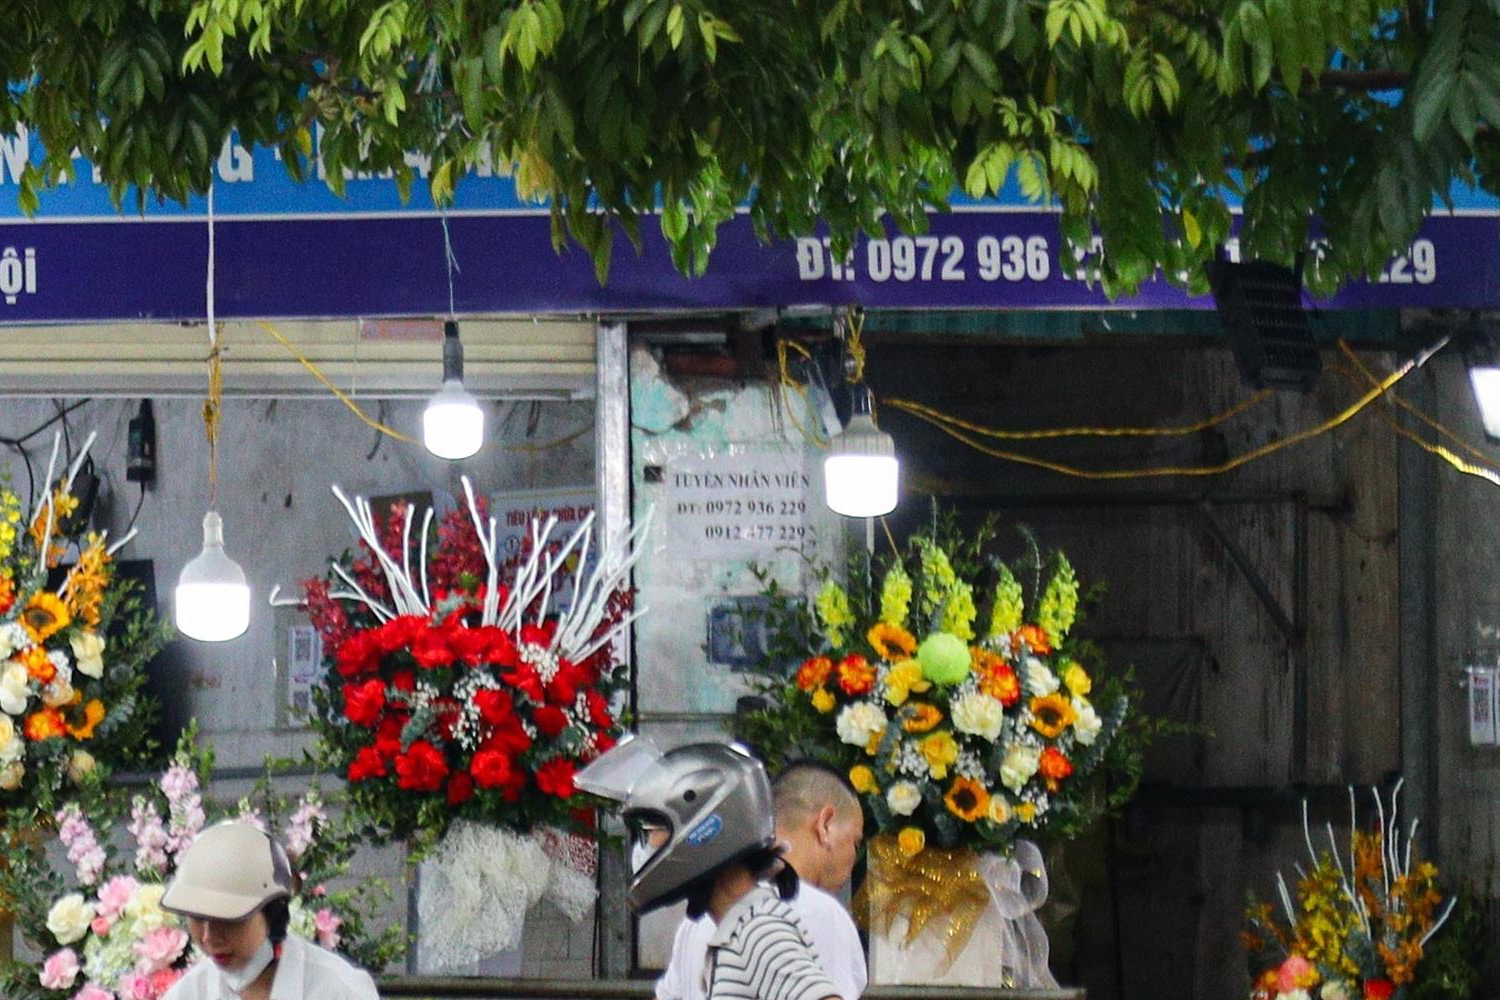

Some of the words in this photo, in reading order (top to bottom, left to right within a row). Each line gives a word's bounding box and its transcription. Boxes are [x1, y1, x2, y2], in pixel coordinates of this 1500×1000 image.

[867, 236, 966, 282] 0972
[977, 236, 1050, 282] 936
[706, 501, 742, 515] 0972
[747, 501, 774, 515] 936
[780, 501, 807, 515] 229
[705, 525, 741, 540] 0912
[779, 525, 806, 540] 229
